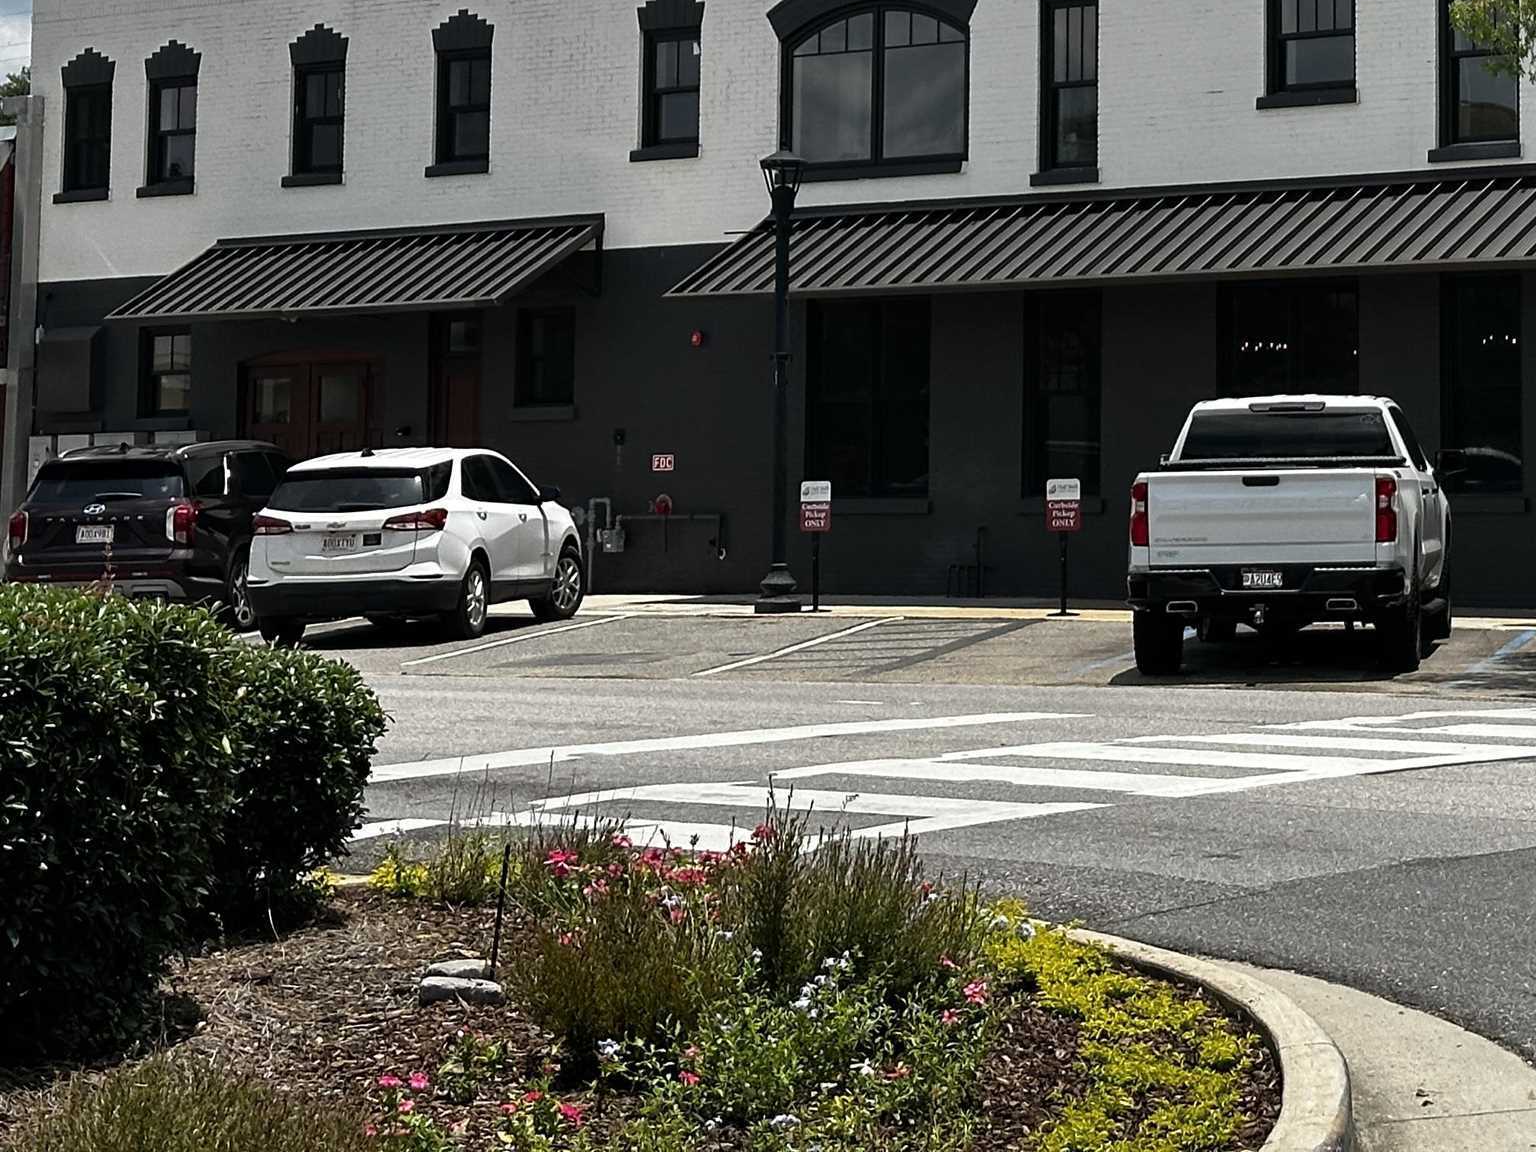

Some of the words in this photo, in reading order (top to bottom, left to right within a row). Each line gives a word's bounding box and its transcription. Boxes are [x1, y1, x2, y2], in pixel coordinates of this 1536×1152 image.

[654, 457, 672, 468] FDC
[804, 519, 825, 528] ONLY
[1052, 519, 1075, 527] ONLY
